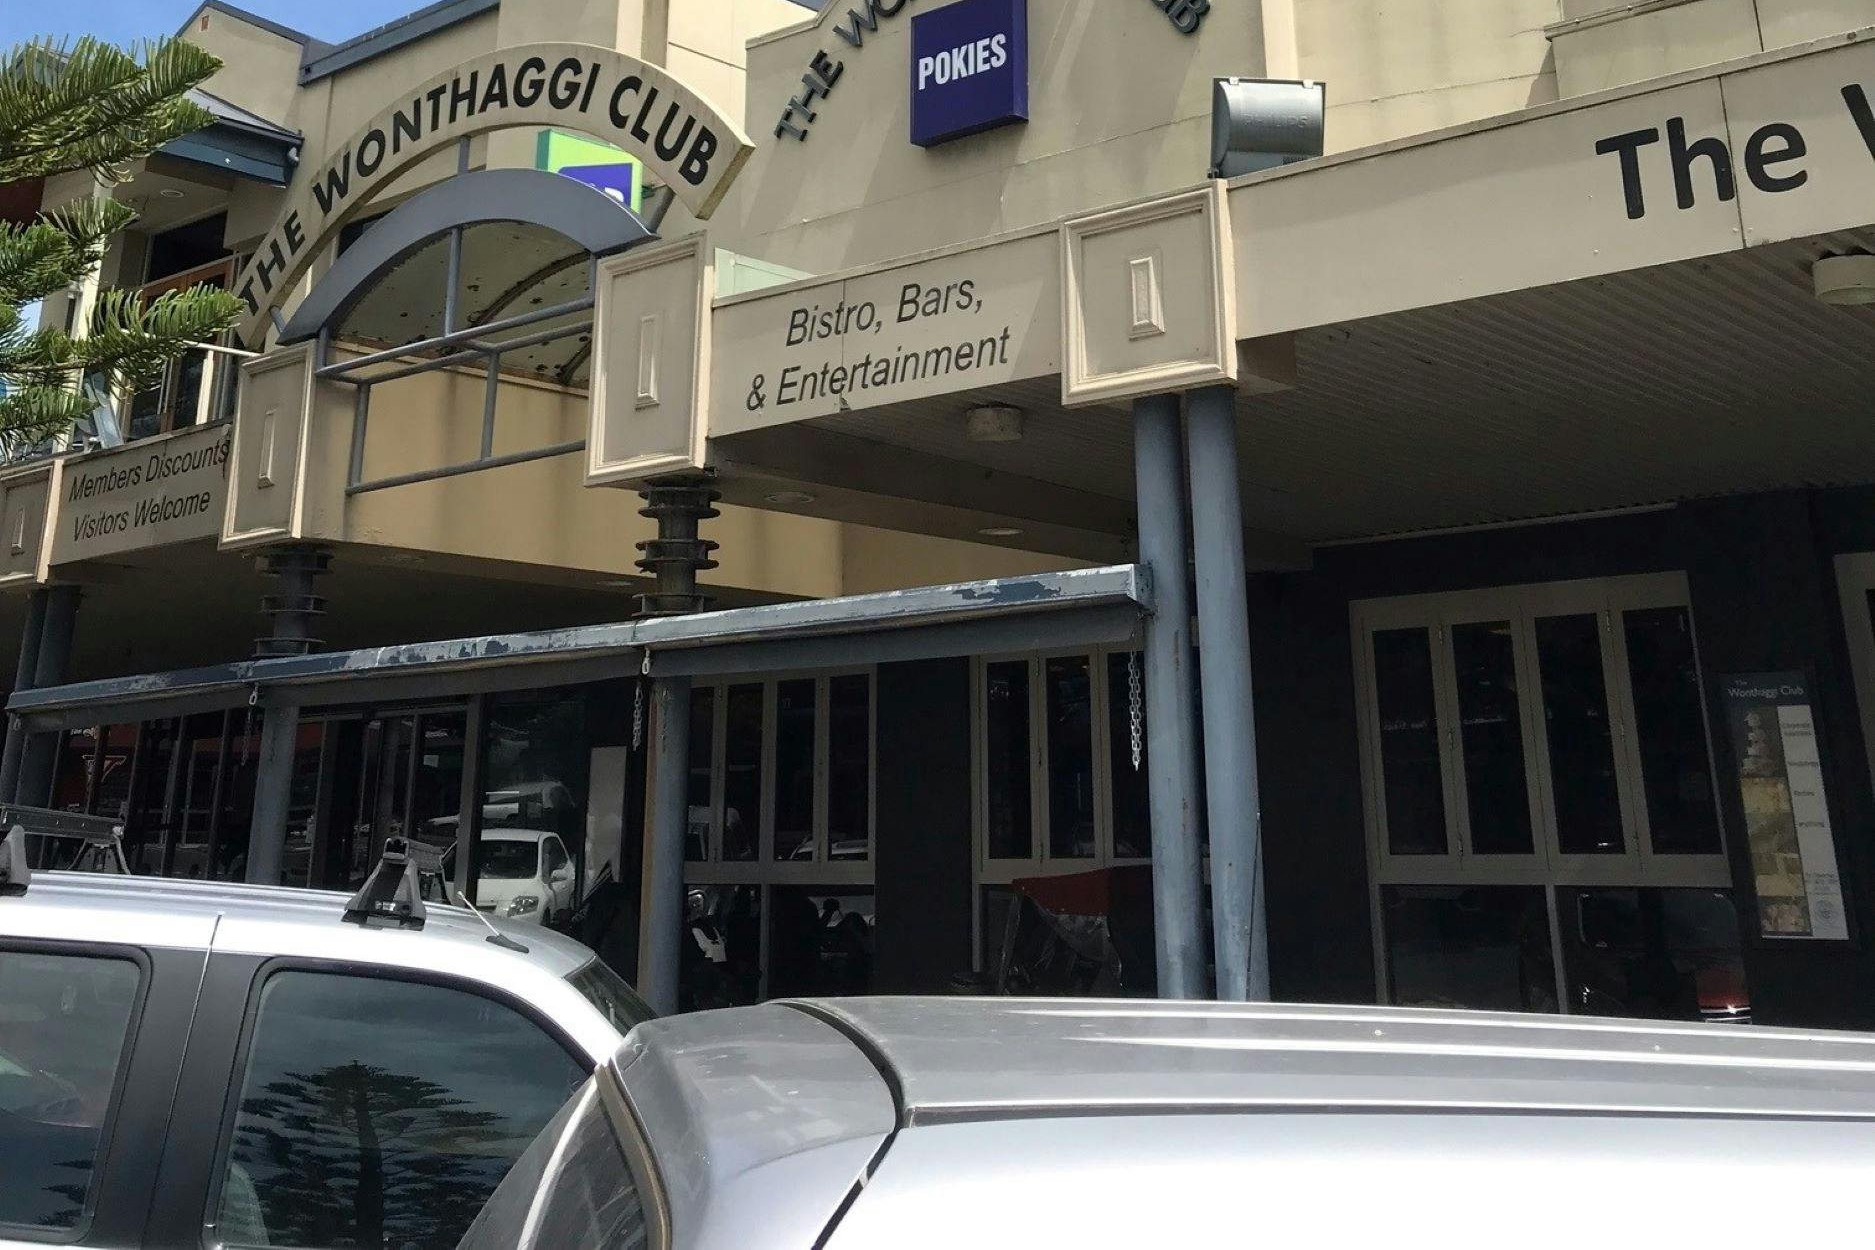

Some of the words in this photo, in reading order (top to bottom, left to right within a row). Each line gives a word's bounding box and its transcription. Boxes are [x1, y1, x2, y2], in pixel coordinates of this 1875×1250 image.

[774, 49, 845, 143] THE
[918, 33, 1008, 91] POKIES
[239, 211, 305, 318] THE
[312, 56, 602, 216] WONTHAGGI
[609, 75, 718, 187] CLUB
[1595, 116, 1808, 220] The
[786, 302, 882, 347] Bistro,
[897, 279, 982, 322] Bars,
[747, 373, 766, 410] &
[777, 325, 1009, 407] Entertainment
[69, 465, 142, 502] Members
[146, 439, 230, 482] Discounts
[74, 508, 129, 541] Visitors
[134, 491, 211, 527] Welcome
